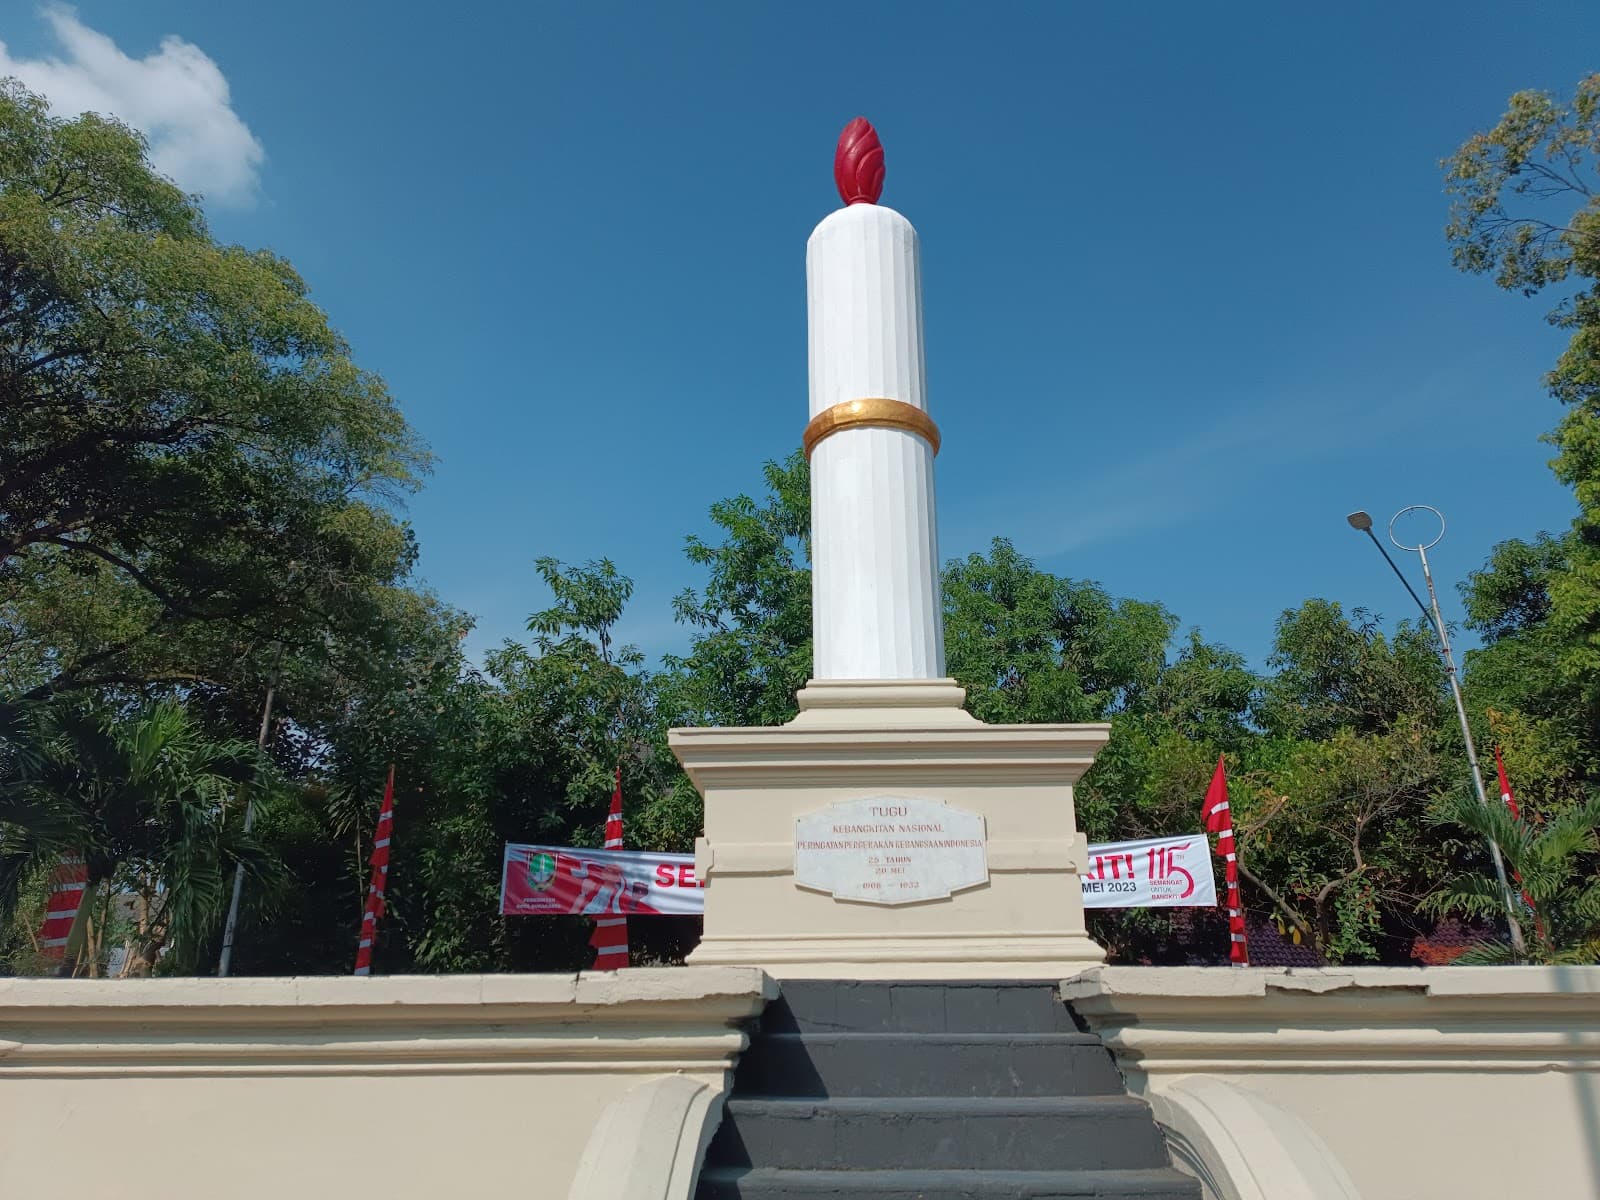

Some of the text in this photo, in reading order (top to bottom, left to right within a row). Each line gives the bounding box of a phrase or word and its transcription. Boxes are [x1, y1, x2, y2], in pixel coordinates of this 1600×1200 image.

[869, 807, 907, 817] TUGU
[833, 824, 944, 833] KEBANGKITAN NASIONAL
[1087, 854, 1135, 880] IT!
[655, 864, 705, 888] SE
[1081, 882, 1137, 893] MEI 2023
